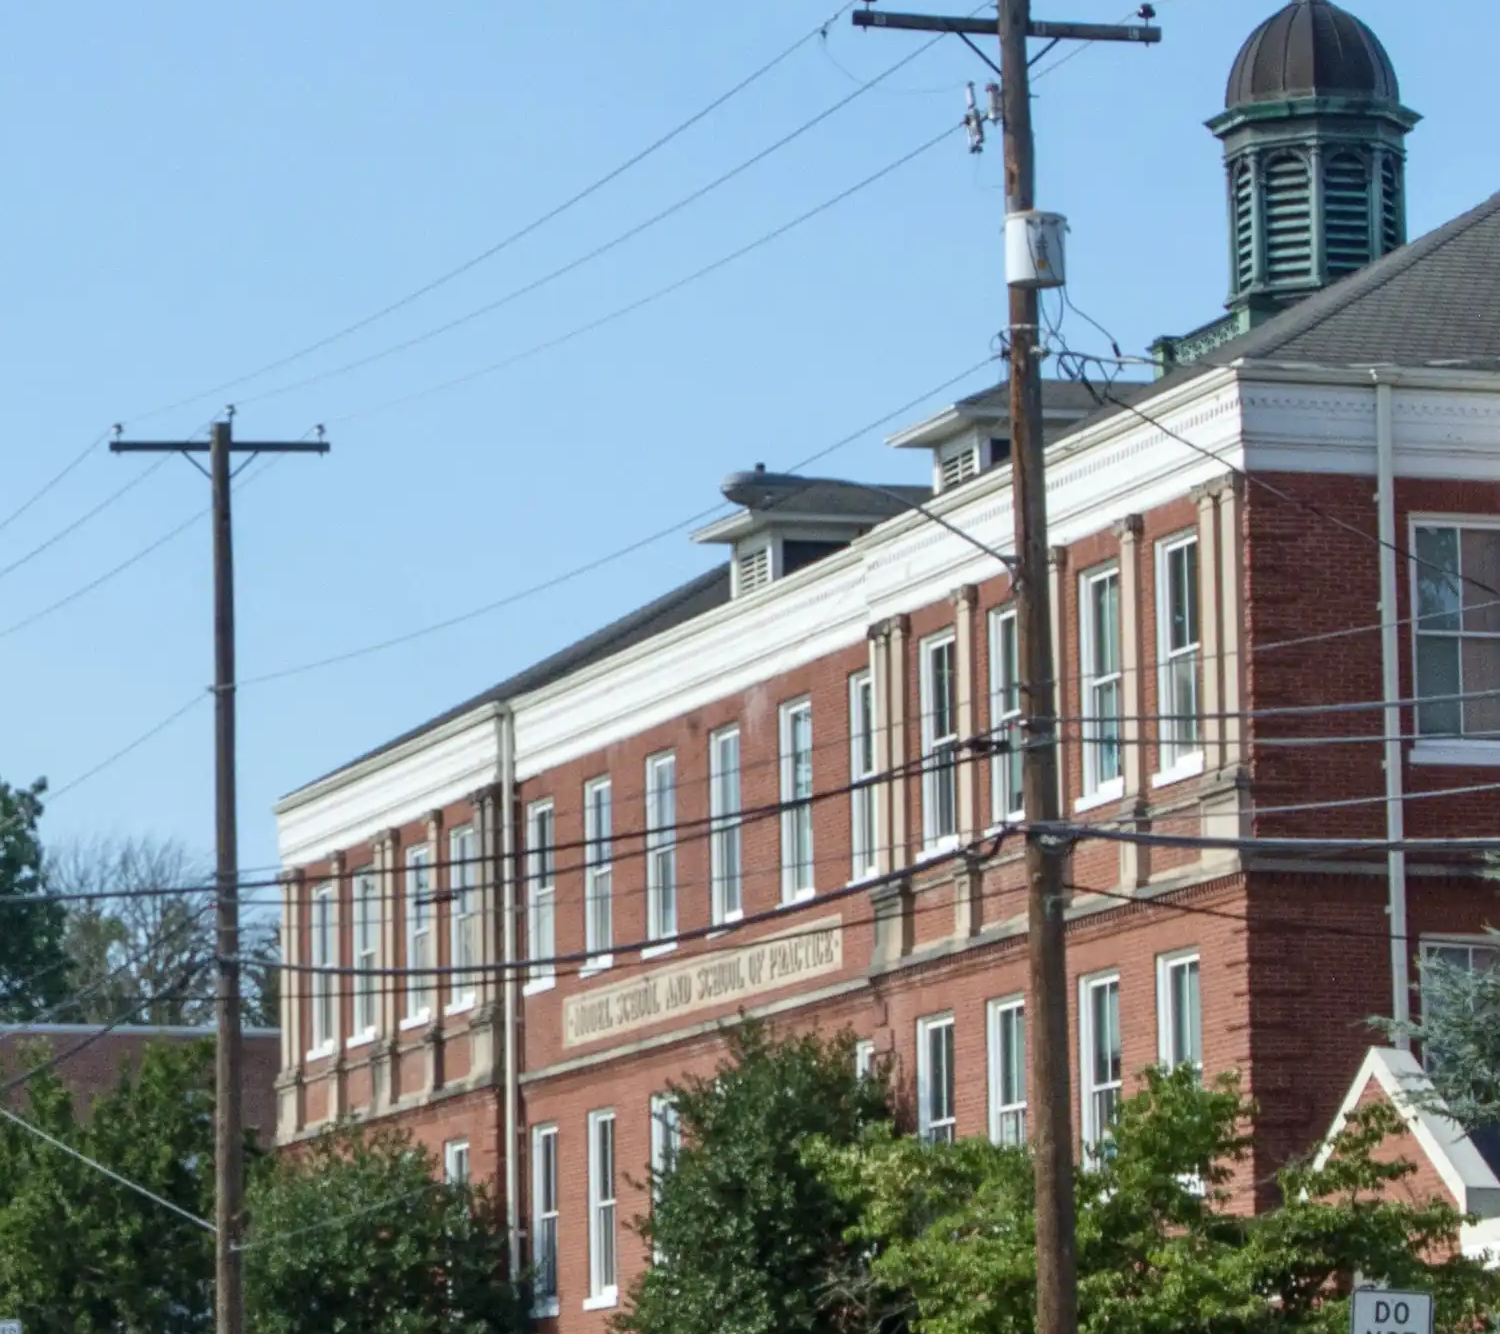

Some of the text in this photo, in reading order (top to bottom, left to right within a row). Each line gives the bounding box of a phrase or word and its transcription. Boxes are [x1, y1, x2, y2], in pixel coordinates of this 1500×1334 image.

[616, 980, 660, 1024] SCHOOL
[666, 974, 691, 1011] AND
[695, 957, 745, 1001] SCHOOL
[749, 950, 765, 986] OF
[769, 929, 834, 980] PRACTICE
[1375, 1300, 1410, 1324] DO
